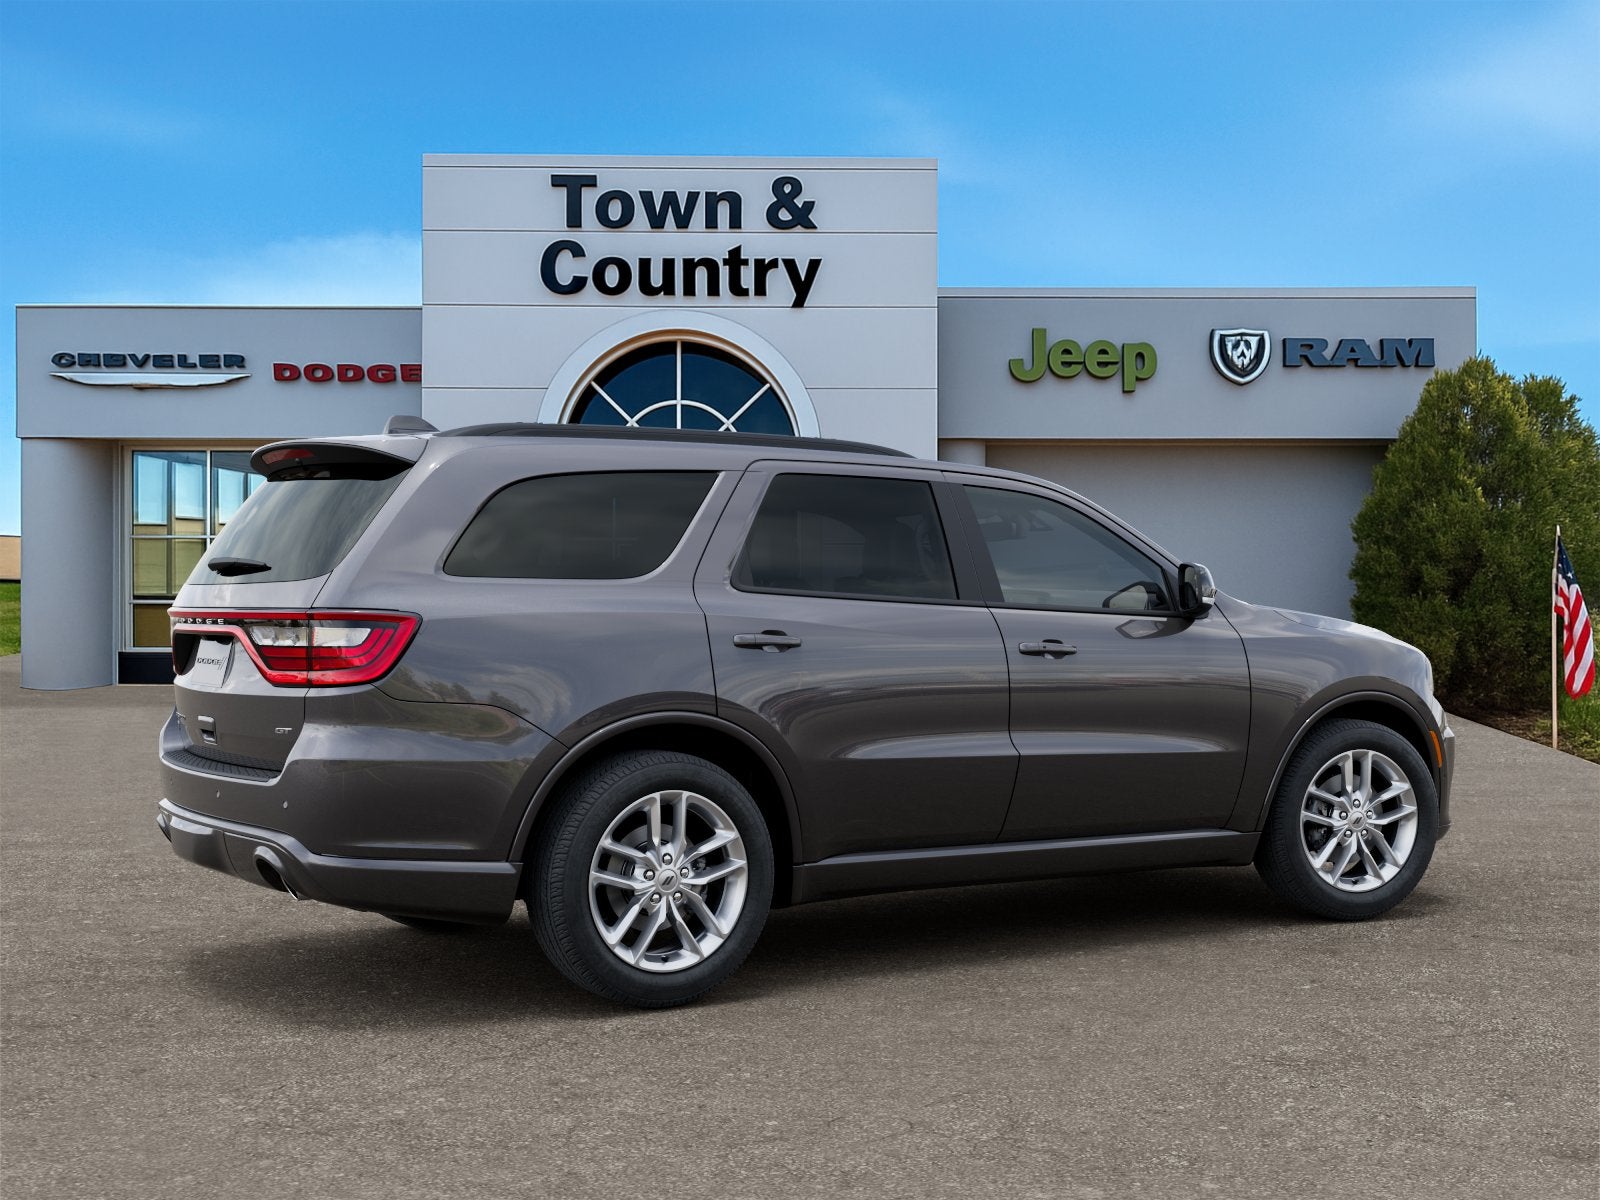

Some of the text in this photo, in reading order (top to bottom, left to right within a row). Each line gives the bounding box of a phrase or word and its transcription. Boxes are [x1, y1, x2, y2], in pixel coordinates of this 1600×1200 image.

[551, 174, 818, 230] Town &
[540, 239, 822, 308] Country
[272, 362, 422, 383] DODGE
[1008, 328, 1158, 393] Jeep
[1282, 337, 1436, 368] RAM
[274, 727, 293, 735] GT
